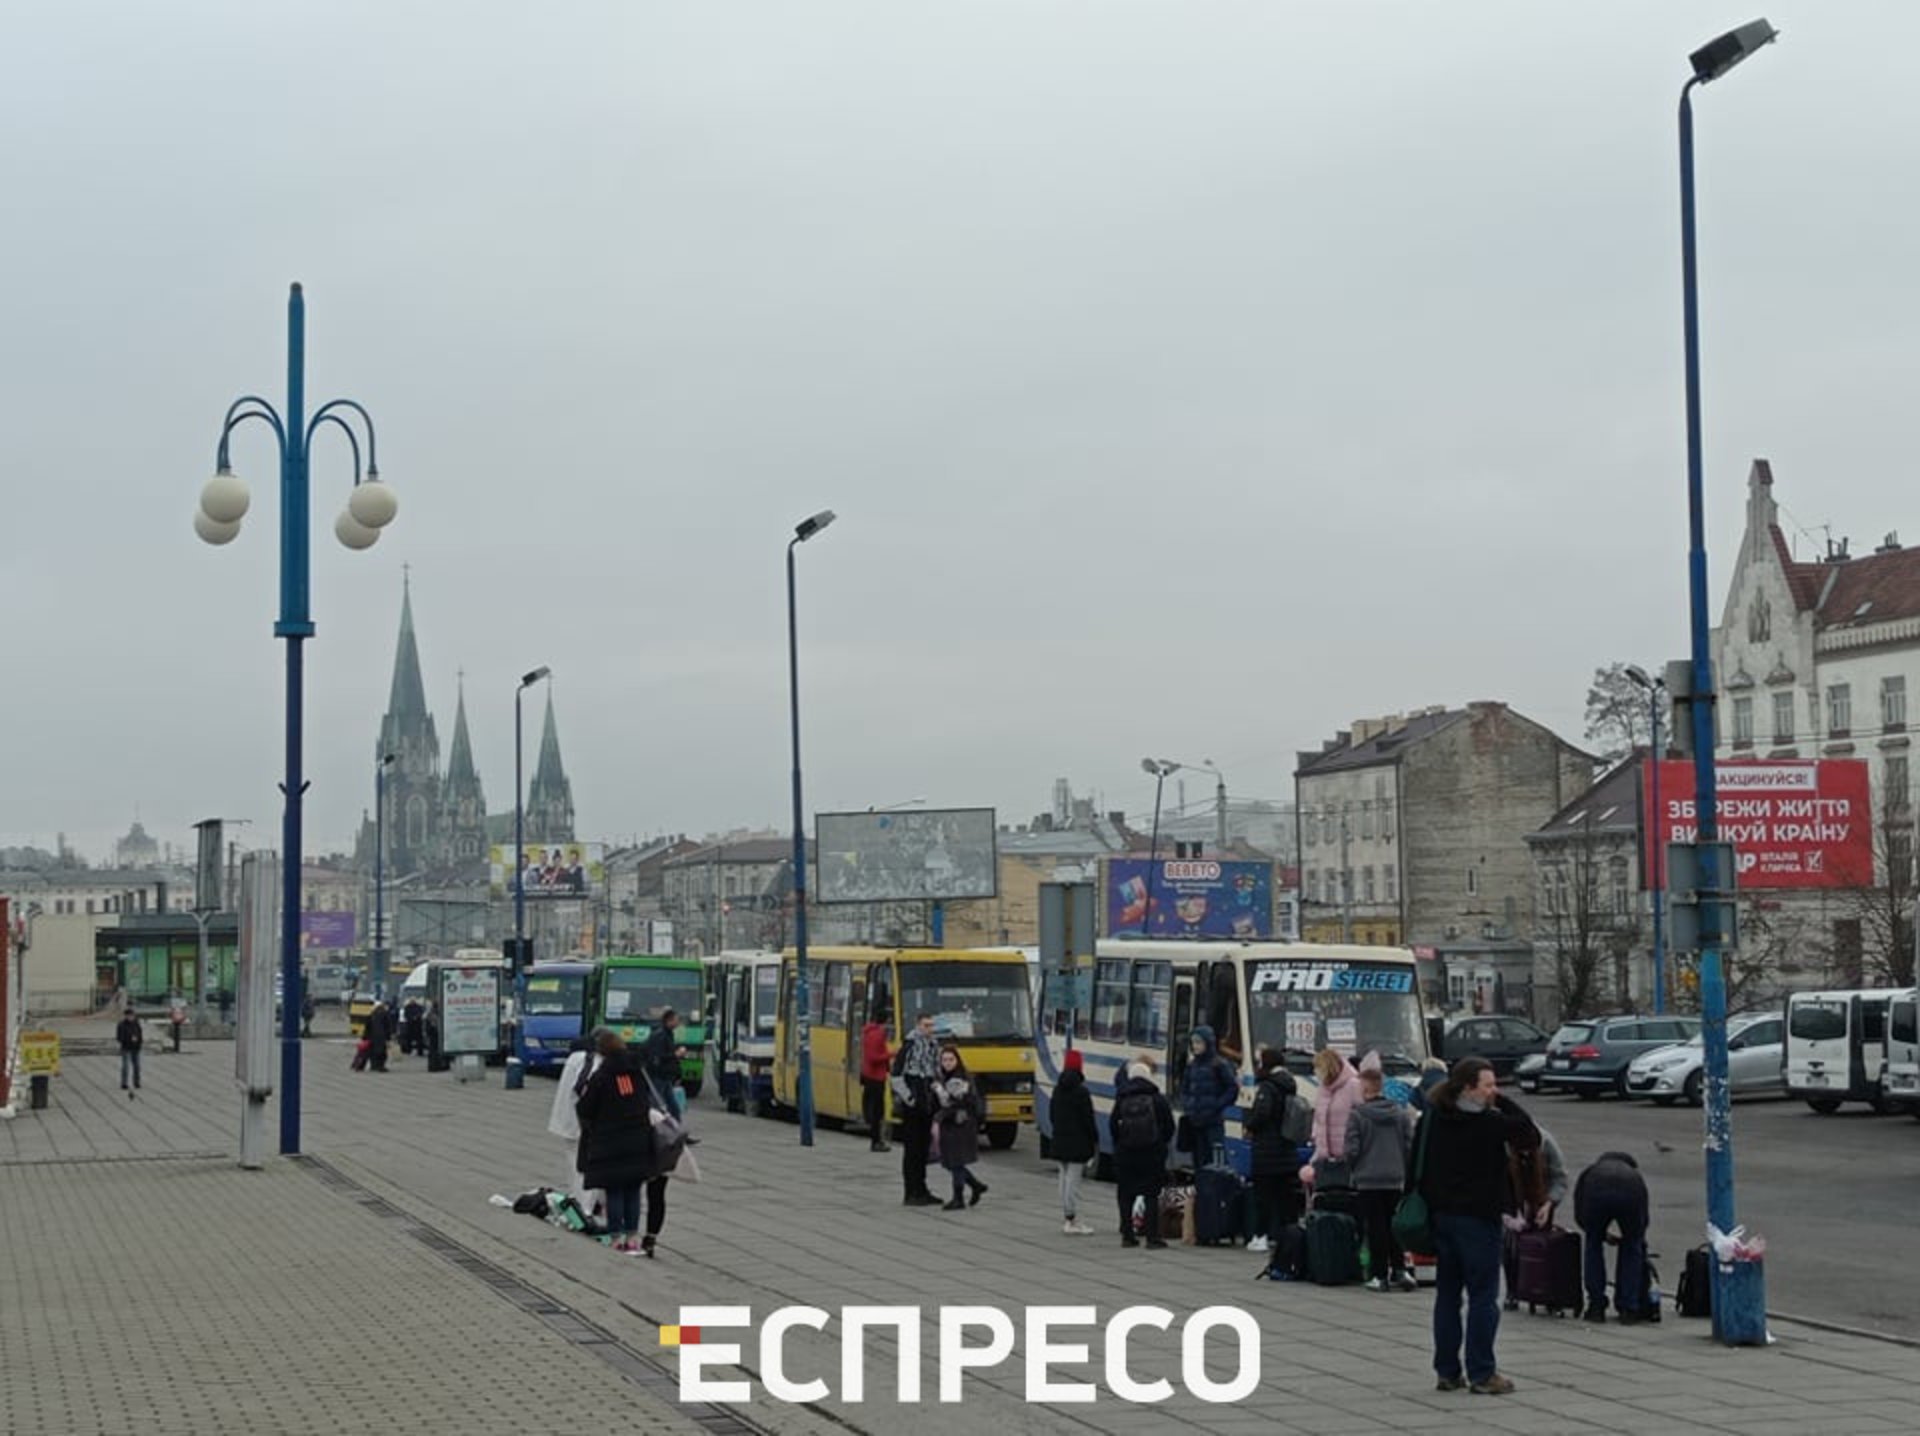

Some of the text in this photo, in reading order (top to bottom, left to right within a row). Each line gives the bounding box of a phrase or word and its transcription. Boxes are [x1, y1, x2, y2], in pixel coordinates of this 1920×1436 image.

[1718, 771, 1808, 786] АКЦИНУЙСЯ!
[1668, 799, 1850, 818] ЗБРЕЖИ ЖИТТЯ
[1671, 821, 1850, 843] ВИІКУЙ КРАЇНУ
[1336, 971, 1410, 990] STREET
[1288, 1022, 1313, 1040] 119
